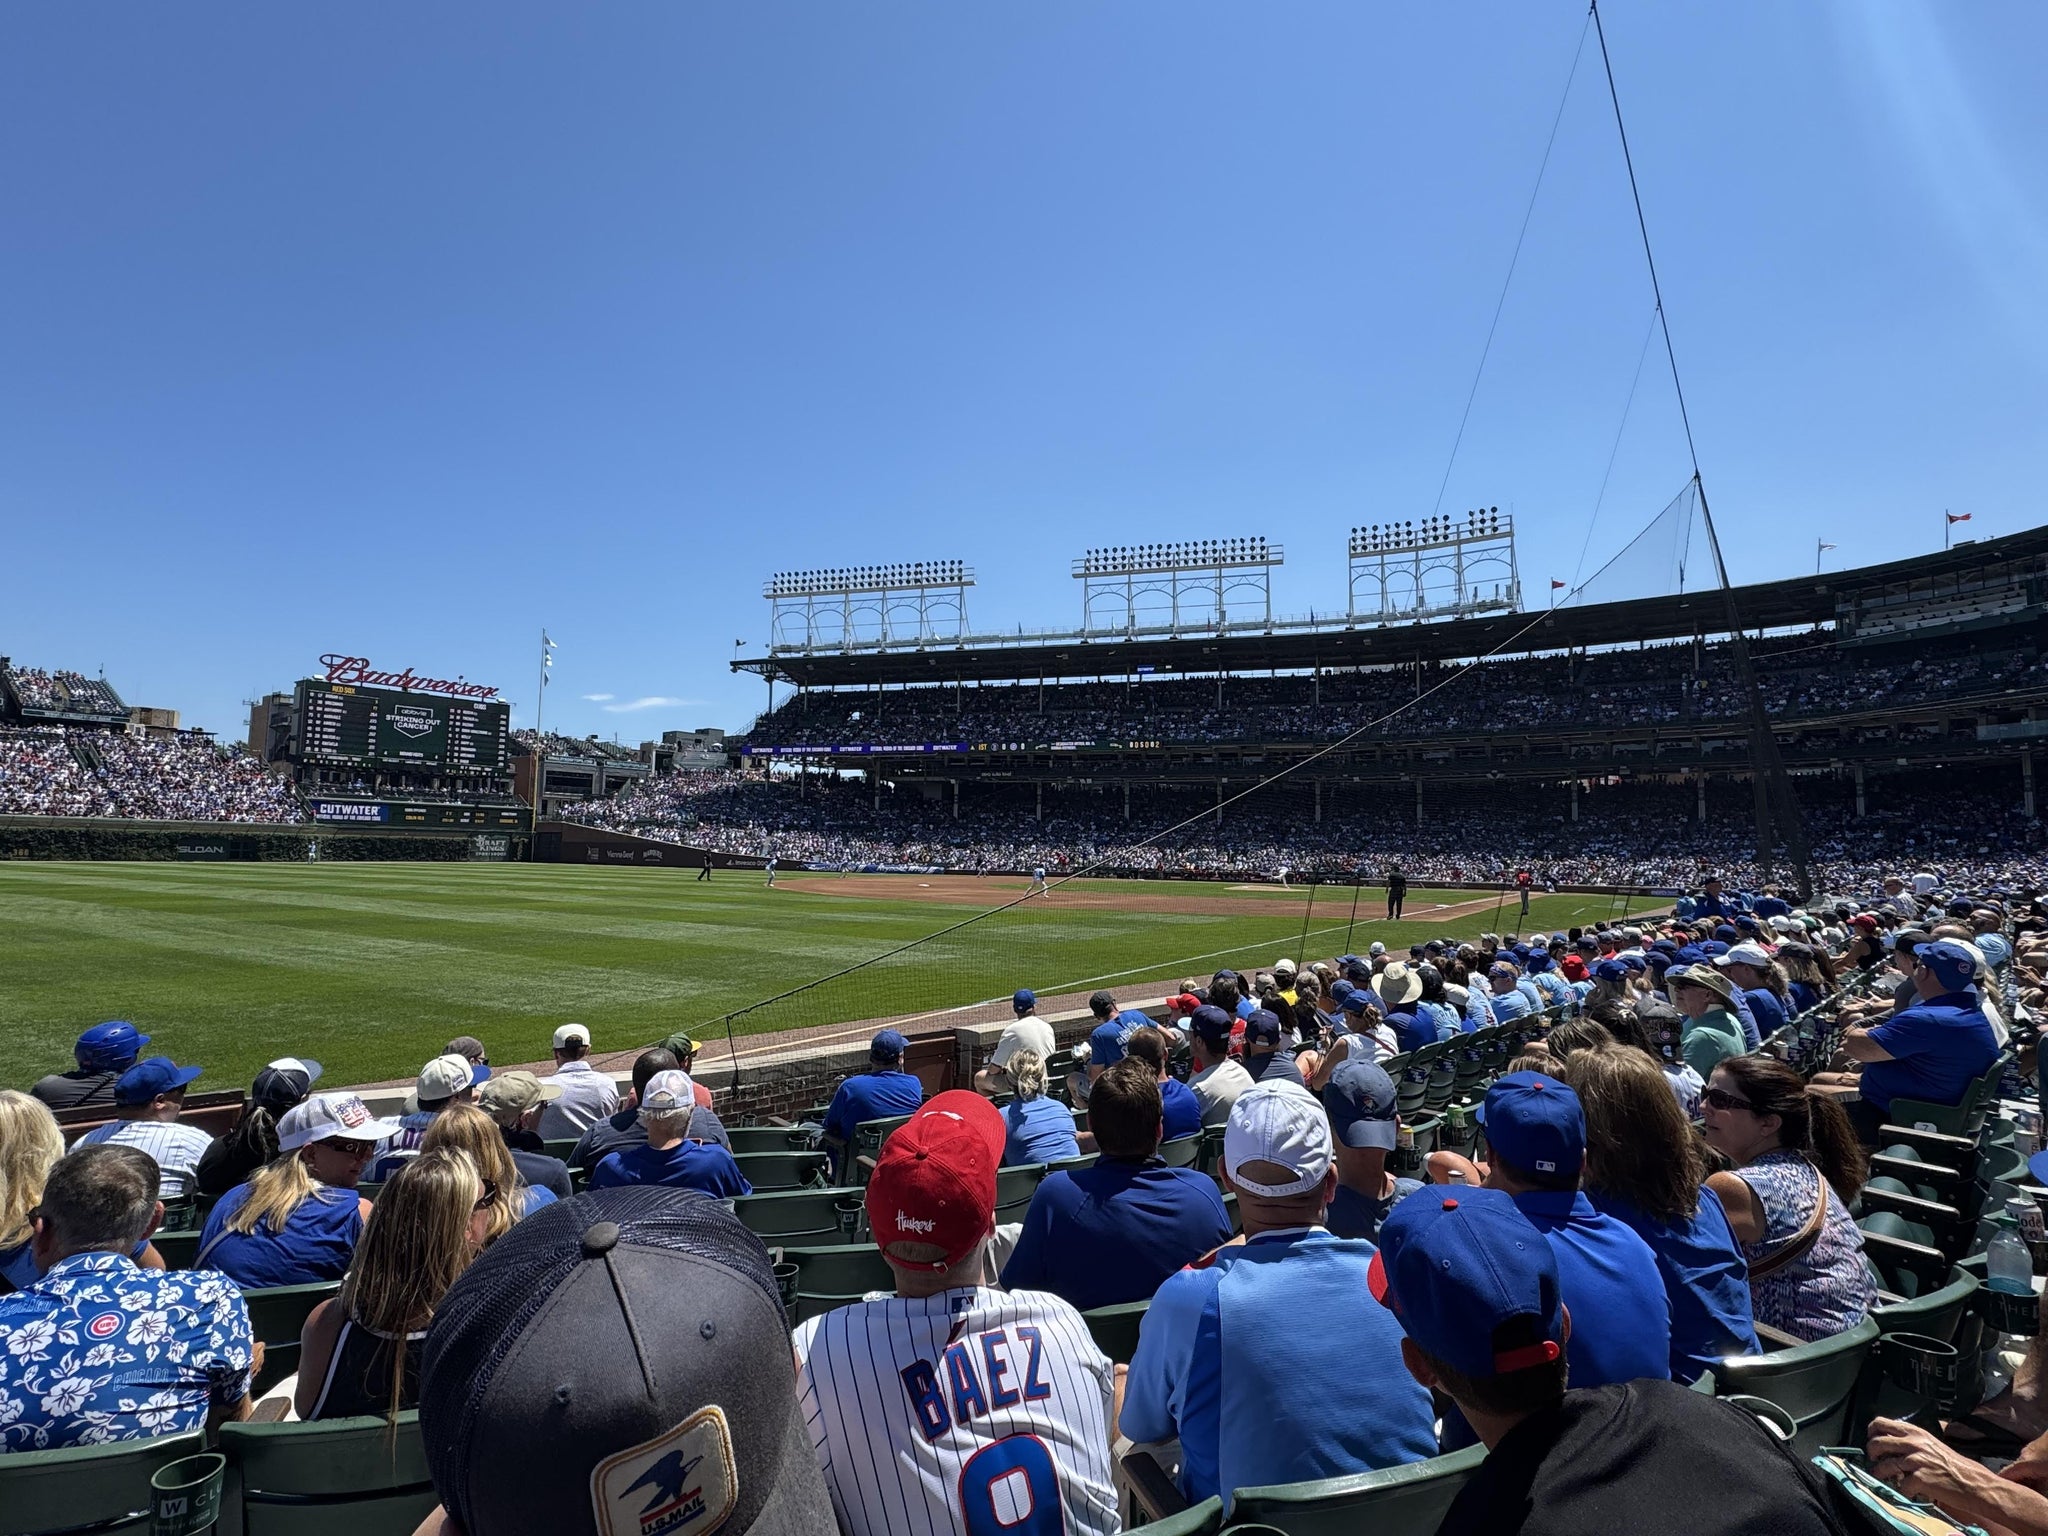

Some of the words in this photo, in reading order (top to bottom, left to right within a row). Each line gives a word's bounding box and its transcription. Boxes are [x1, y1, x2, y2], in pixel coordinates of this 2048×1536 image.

[319, 654, 501, 698] Budweiser
[385, 714, 424, 724] STRIKING
[397, 721, 430, 731] CANCER
[320, 804, 379, 815] CUTWATER
[476, 840, 506, 848] DRAFT
[895, 1209, 936, 1235] Huskers
[165, 1500, 183, 1516] W
